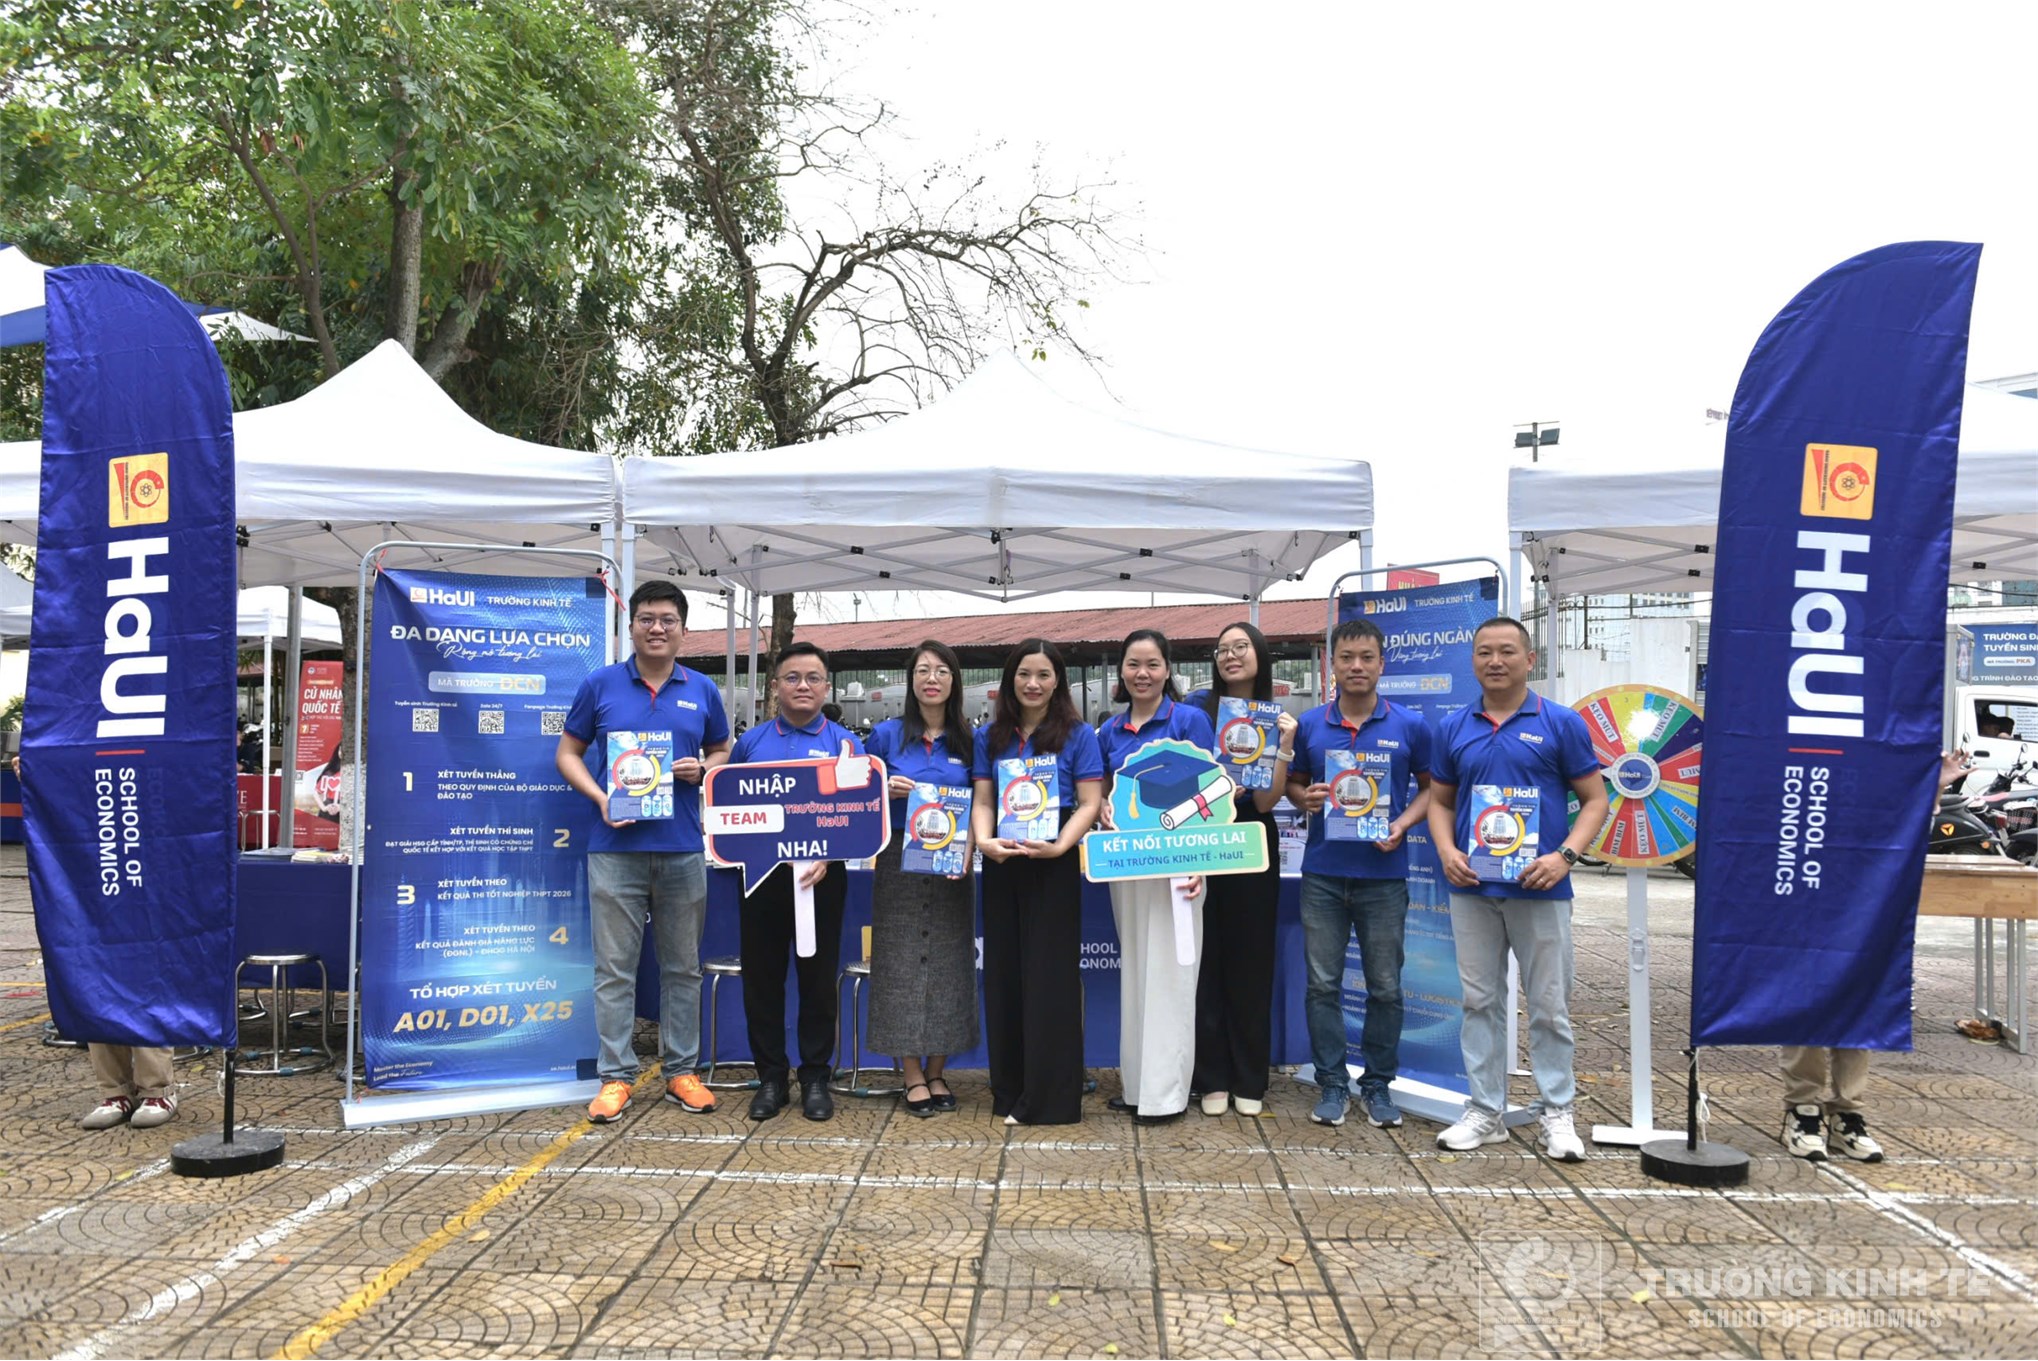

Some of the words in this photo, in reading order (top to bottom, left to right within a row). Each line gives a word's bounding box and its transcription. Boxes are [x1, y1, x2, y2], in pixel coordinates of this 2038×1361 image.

[429, 588, 475, 607] HaUI
[487, 594, 531, 606] TRƯỜNG
[532, 597, 558, 607] KINH
[559, 595, 573, 608] TẾ
[1376, 597, 1407, 614] HaUI
[1415, 596, 1446, 608] TRƯỜNG
[1446, 595, 1463, 605] KINH
[1463, 593, 1474, 603] TẾ
[96, 536, 169, 738] HaUI
[390, 625, 422, 641] ĐA
[426, 627, 486, 645] DẠNG
[489, 630, 530, 647] LỰA
[534, 633, 591, 649] CHỌN
[1390, 630, 1431, 648] ĐÚNG
[1434, 626, 1476, 645] NGÀN
[1787, 530, 1870, 737] HaUI
[1983, 631, 2027, 641] TRƯỜNG
[1983, 643, 2019, 652] TUYỂN
[2020, 644, 2038, 652] SIN
[454, 677, 494, 689] TRƯỜNG
[303, 686, 319, 700] CỬ
[302, 700, 328, 715] QUỐC
[330, 700, 342, 714] TẾ
[1257, 702, 1281, 714] HaUI
[1590, 702, 1605, 721] KẸO
[647, 731, 672, 742] HaUI
[1034, 755, 1057, 766] HaUI
[1366, 752, 1391, 763] HaUI
[403, 771, 413, 792] 1
[438, 769, 455, 779] XÉT
[456, 769, 484, 779] TUYỂN
[459, 784, 476, 792] QUY
[477, 784, 497, 793] ĐỊNH
[498, 782, 515, 792] CỦA
[517, 784, 528, 793] BỘ
[529, 782, 549, 792] GIÁO
[550, 785, 566, 794] DỤC
[738, 773, 797, 798] NHẬP
[948, 786, 971, 799] HaUI
[1513, 787, 1539, 799] HaUI
[437, 791, 456, 800] ĐÀO
[457, 793, 473, 801] TẠO
[119, 767, 140, 852] SCHOOL
[784, 801, 833, 815] TRƯỜNG
[835, 802, 865, 813] KINH
[866, 797, 882, 812] TẾ
[1803, 767, 1829, 854] SCHOOL
[720, 812, 767, 826] TEAM
[817, 815, 850, 828] HaUI
[95, 769, 120, 896] ECONOMICS
[450, 825, 466, 835] XÉT
[467, 824, 497, 835] TUYỂN
[498, 826, 512, 835] THÍ
[513, 827, 534, 835] SINH
[1614, 822, 1625, 839] BIM
[1774, 766, 1804, 896] ECONOMICS
[553, 829, 571, 848] 2
[1103, 837, 1128, 853] KẾT
[1132, 832, 1162, 851] NỐI
[1164, 832, 1219, 849] TƯƠNG
[1223, 831, 1247, 844] LAI
[1611, 839, 1622, 855] BIM
[777, 840, 828, 859] NHA!
[1108, 858, 1125, 870] TẠI
[1126, 854, 1170, 868] TRƯỜNG
[1172, 854, 1198, 864] KINH
[1199, 850, 1212, 862] TẾ
[1219, 851, 1244, 861] HaUI
[126, 861, 142, 887] OF
[438, 879, 454, 889] XÉT
[456, 876, 484, 887] TUYỂN
[484, 878, 507, 886] THEO
[1801, 861, 1820, 889] OF
[397, 884, 416, 905] 3
[437, 891, 451, 901] KẾT
[453, 890, 471, 900] QUẢ
[485, 889, 501, 899] TỐT
[463, 925, 480, 935] XÉT
[482, 924, 511, 934] TUYỂN
[512, 924, 536, 933] THEO
[549, 926, 569, 945] 4
[415, 940, 431, 950] KẾT
[432, 938, 451, 949] QUẢ
[1080, 942, 1118, 954] HOOL
[409, 982, 432, 999] TỔ
[435, 985, 470, 999] HỢP
[472, 982, 502, 996] XÉT
[505, 975, 557, 993] TUYỂN
[392, 1009, 452, 1033] A01,
[458, 1004, 516, 1028] D01,
[521, 1000, 574, 1023] X25
